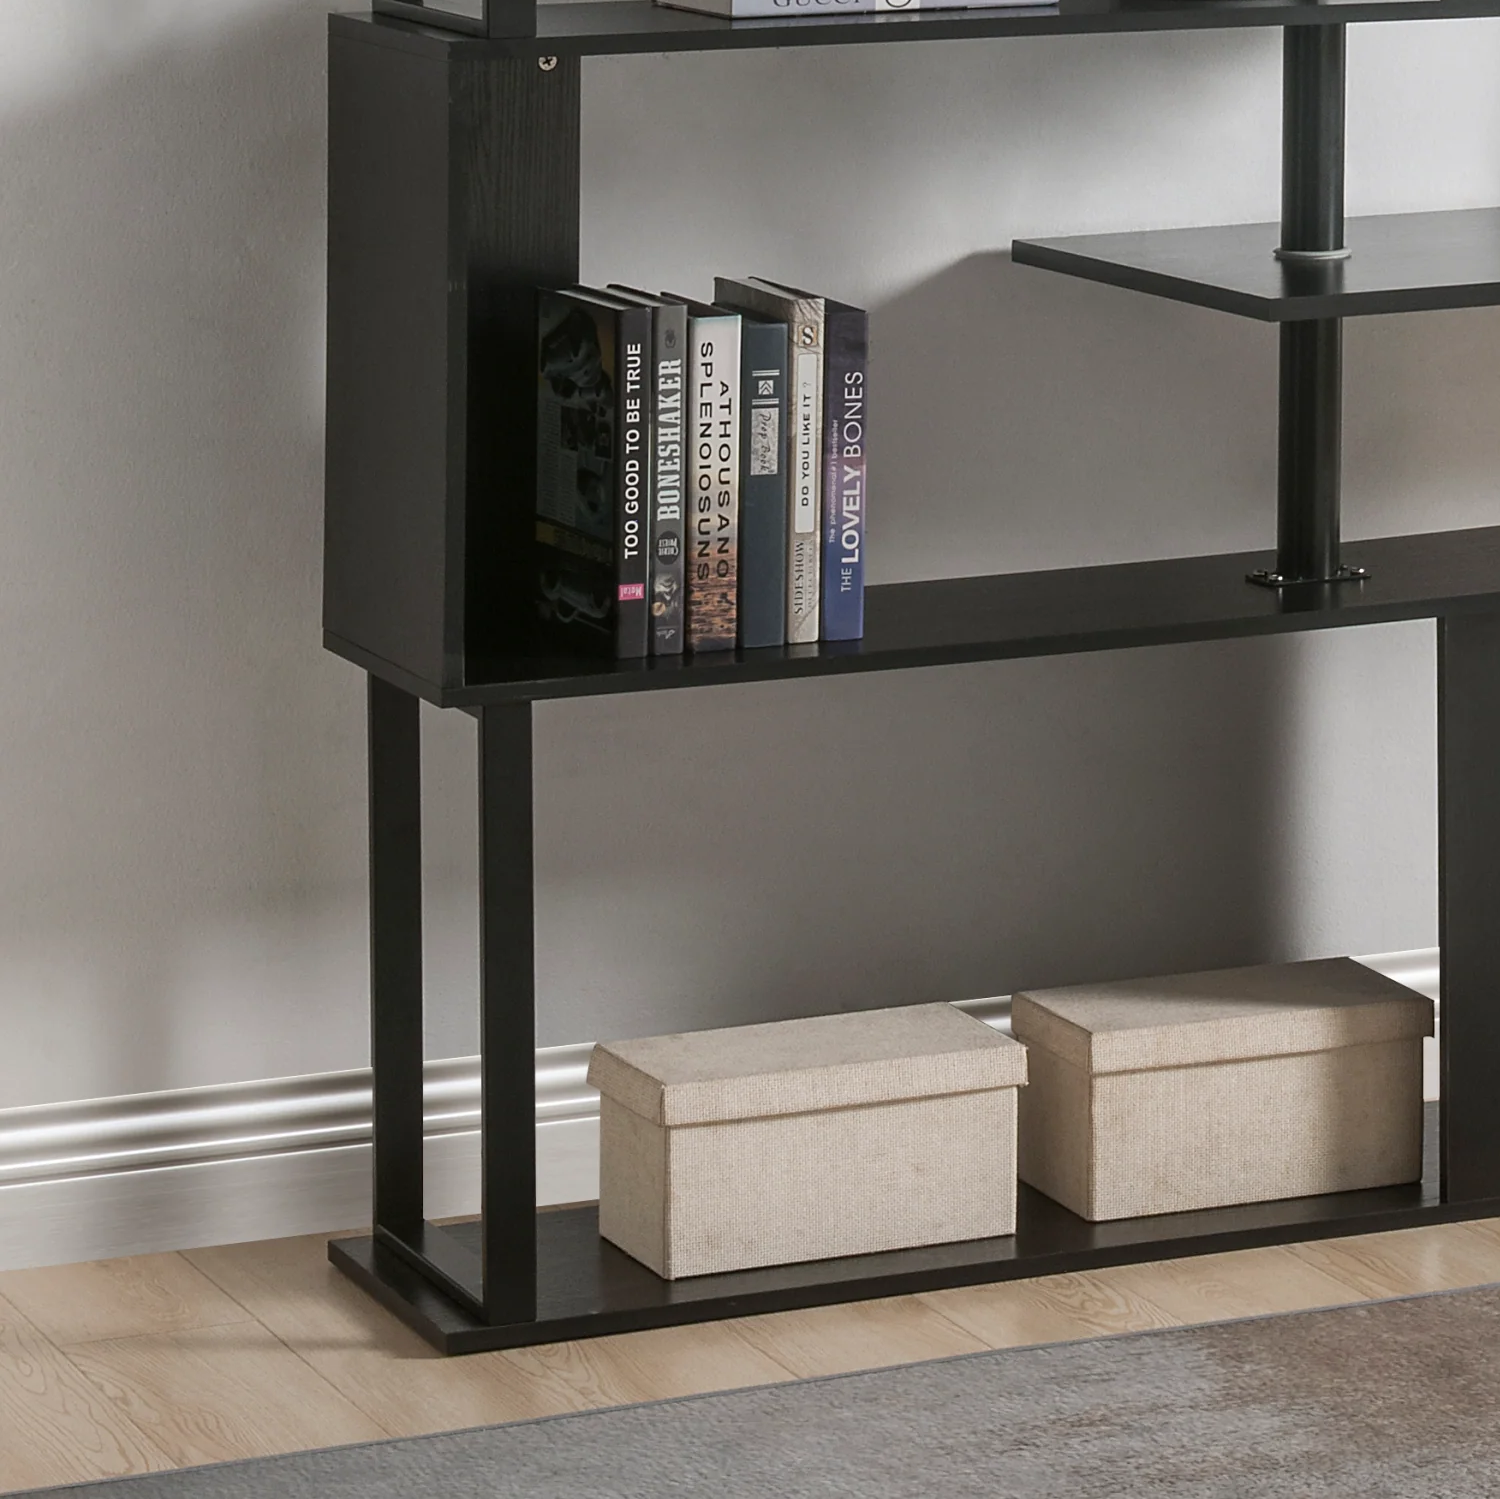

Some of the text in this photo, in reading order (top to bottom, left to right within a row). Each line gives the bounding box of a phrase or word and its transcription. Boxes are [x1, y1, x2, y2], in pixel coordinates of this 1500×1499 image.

[803, 394, 811, 408] IT
[624, 343, 641, 560] TOO GOOD TO BE TRUE
[656, 358, 682, 521] BONESHAKER
[802, 413, 811, 445] LIKE
[801, 450, 810, 479] YOU
[841, 371, 863, 592] THE LOVELY BONES
[801, 486, 809, 507] DO
[794, 542, 804, 614] SIDESHOW
